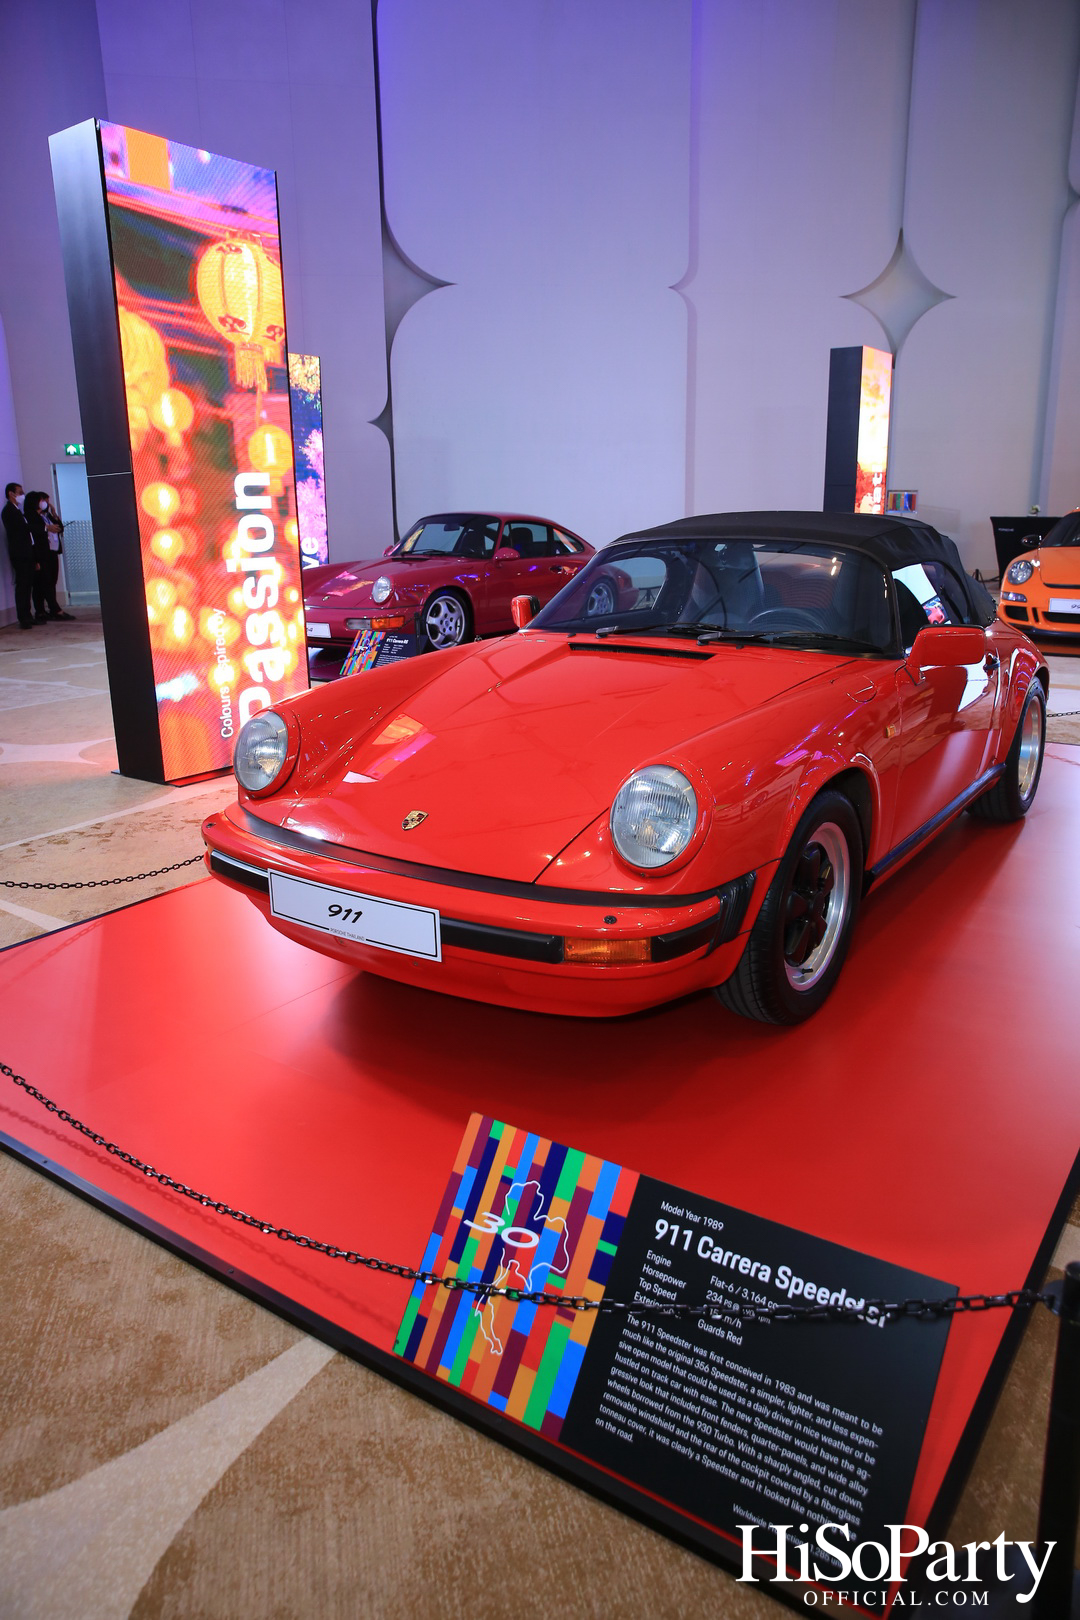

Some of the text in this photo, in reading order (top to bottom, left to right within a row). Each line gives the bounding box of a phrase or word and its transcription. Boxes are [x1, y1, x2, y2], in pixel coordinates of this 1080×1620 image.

[212, 627, 231, 684] spired
[219, 685, 234, 738] Colours
[328, 904, 363, 923] 911
[661, 1201, 724, 1231] Model Year 1989
[643, 1264, 687, 1289] Horsepower
[647, 1250, 672, 1267] Engine
[655, 1219, 693, 1251] 911
[698, 1236, 772, 1283] Carrera
[640, 1277, 677, 1301] Top Speed
[706, 1290, 723, 1304] 234
[724, 1299, 733, 1308] PS
[710, 1276, 734, 1293] Flat-6
[742, 1288, 767, 1306] 3,164
[698, 1319, 743, 1346] Guards Red
[623, 1329, 642, 1342] much
[642, 1336, 655, 1348] like
[656, 1343, 667, 1354] the
[668, 1349, 694, 1366] original
[694, 1359, 710, 1373] 356
[711, 1367, 749, 1392] Speedster,
[757, 1389, 786, 1409] simpler,
[788, 1402, 814, 1422] lighter,
[816, 1416, 832, 1428] and
[832, 1422, 849, 1436] less
[850, 1432, 878, 1448] expen-
[628, 1314, 883, 1436] The 911 Speedster was first conceived in 1983 and was meant to be
[615, 1352, 871, 1480] hustled on track car with ease. The new Speedster would have the ag-
[619, 1341, 633, 1352] sive
[633, 1348, 650, 1360] open
[650, 1356, 673, 1371] model
[673, 1365, 687, 1378] that
[688, 1373, 708, 1387] could
[708, 1381, 718, 1392] be
[719, 1387, 737, 1401] used
[737, 1396, 746, 1405] as
[753, 1403, 771, 1418] daily
[772, 1411, 794, 1426] driver
[794, 1420, 802, 1431] in
[803, 1426, 820, 1439] nice
[822, 1435, 854, 1454] weather
[855, 1450, 864, 1459] or
[865, 1453, 876, 1465] be
[596, 1418, 633, 1442] on the road.
[608, 1379, 631, 1396] wheels
[632, 1389, 664, 1412] borrowed
[665, 1406, 682, 1420] from
[683, 1415, 695, 1427] the
[697, 1421, 712, 1435] 930
[714, 1429, 735, 1447] Turbo.
[738, 1440, 756, 1457] With
[764, 1456, 792, 1476] sharply
[793, 1470, 821, 1490] angled,
[824, 1485, 838, 1497] cut
[839, 1492, 863, 1511] down,
[611, 1367, 868, 1496] gressive look that included front fenders, quarter-panels, and wide alloy
[600, 1404, 627, 1423] tonneau
[628, 1419, 647, 1435] cover,
[649, 1428, 655, 1438] it
[656, 1434, 670, 1446] was
[671, 1441, 695, 1459] clearly
[702, 1455, 739, 1480] Speedster
[740, 1476, 756, 1489] and
[756, 1482, 763, 1493] it
[764, 1486, 790, 1507] looked
[791, 1500, 805, 1514] like
[603, 1392, 860, 1526] removable windshield and the rear of the cockpit covered by a fiberglass
[733, 1502, 767, 1528] Worldwide
